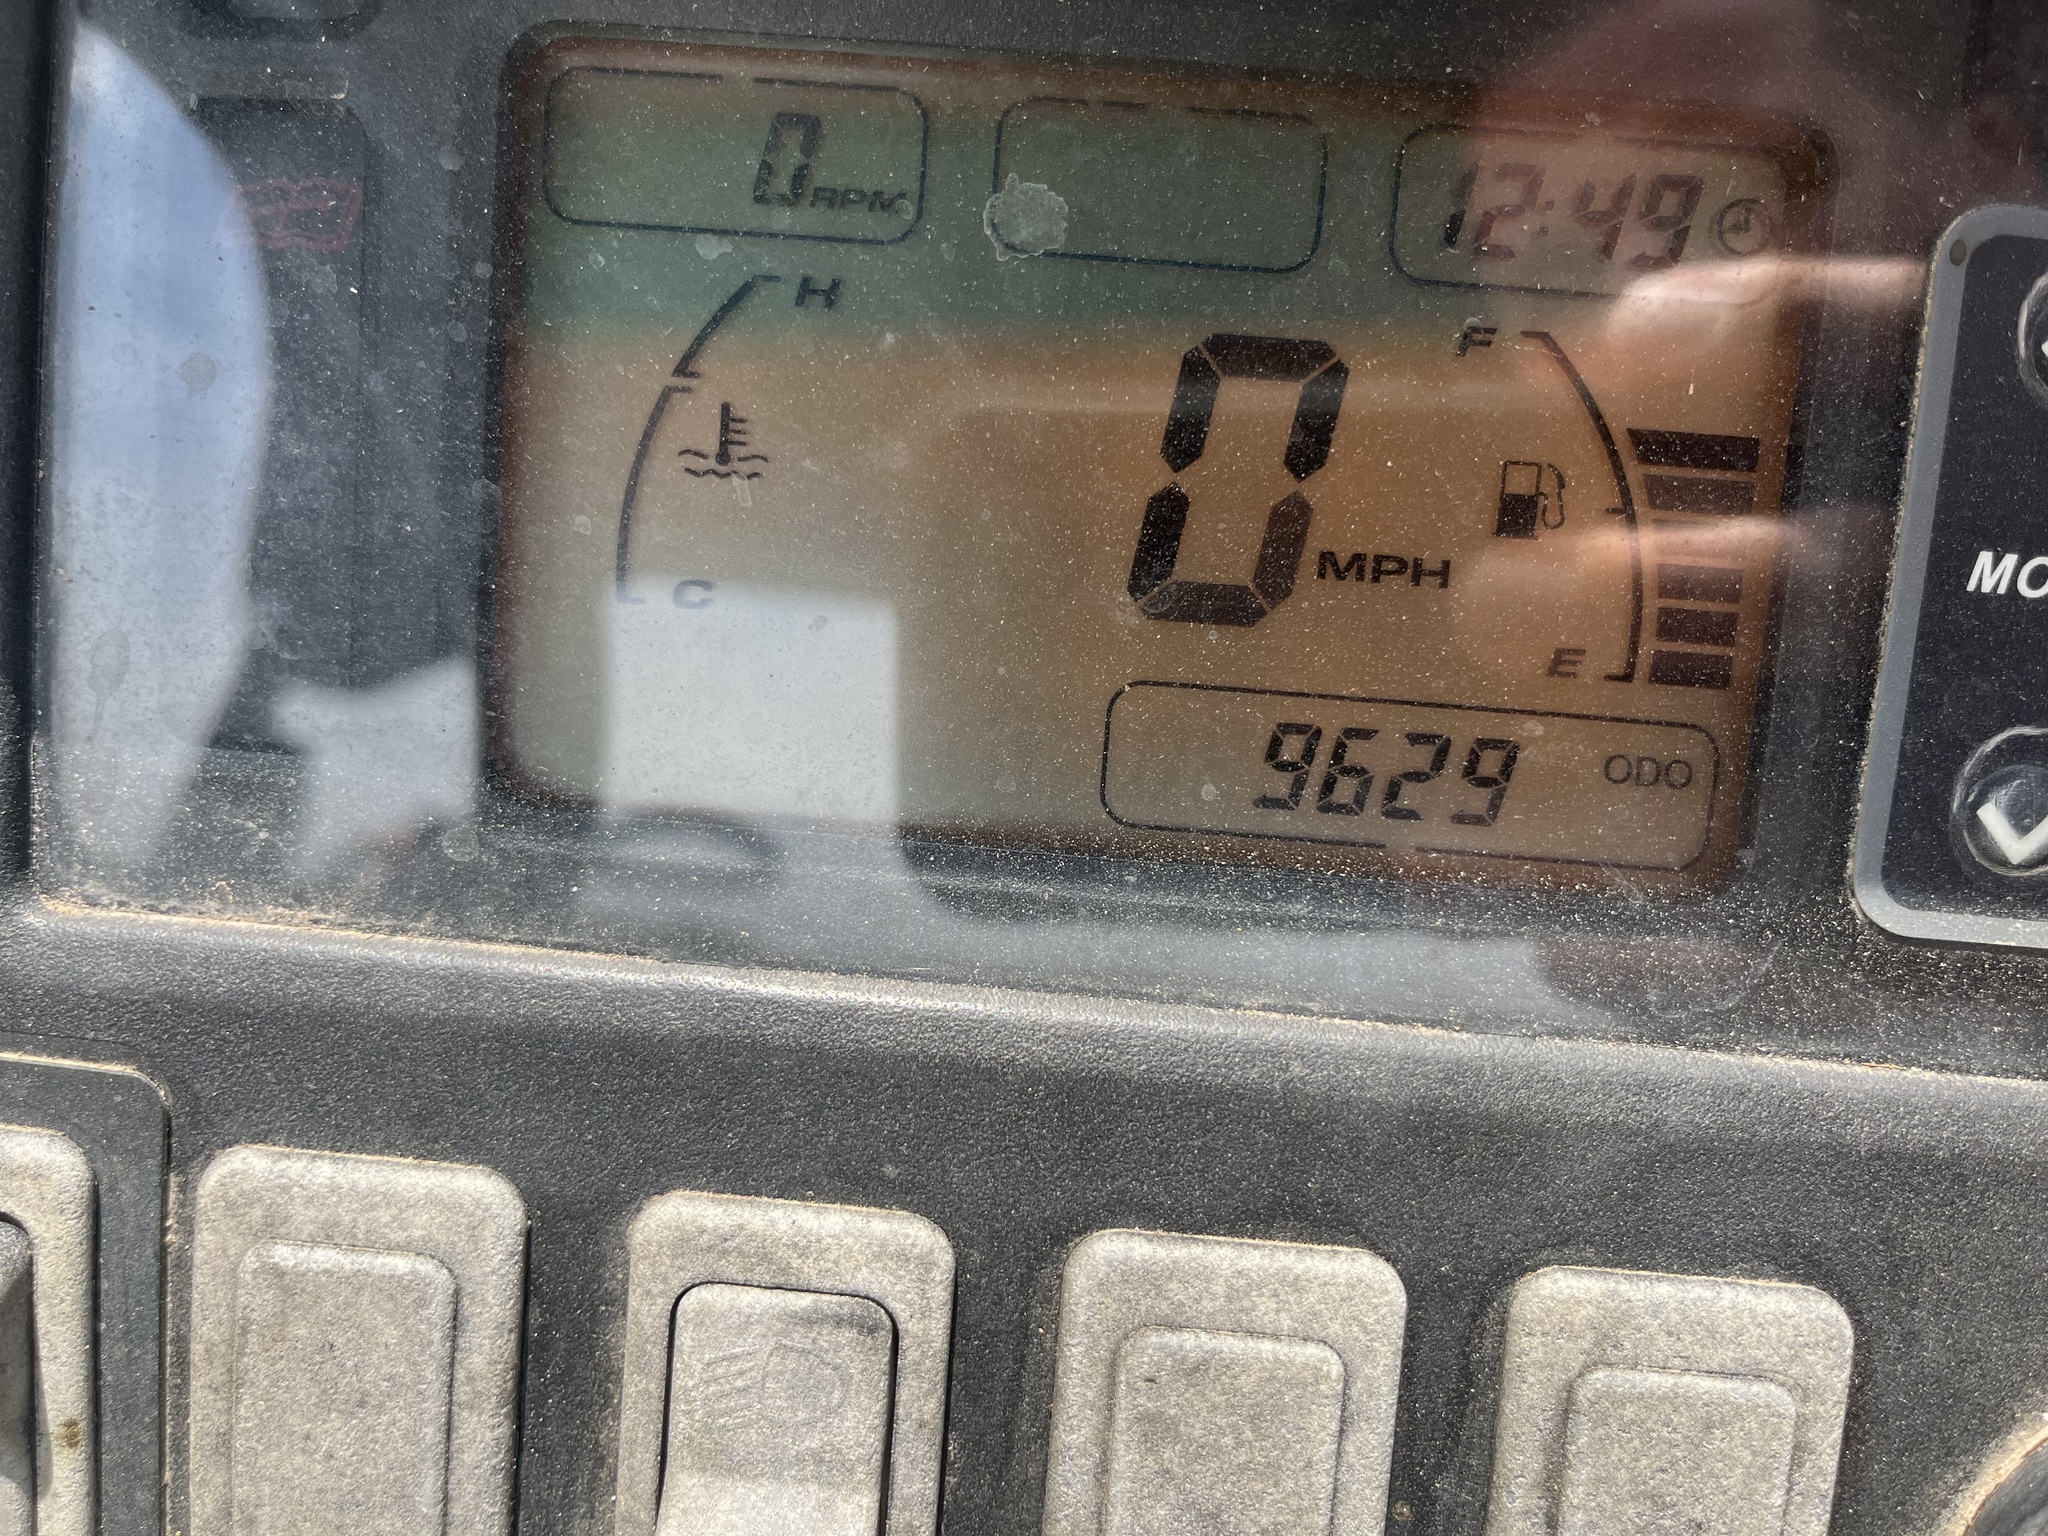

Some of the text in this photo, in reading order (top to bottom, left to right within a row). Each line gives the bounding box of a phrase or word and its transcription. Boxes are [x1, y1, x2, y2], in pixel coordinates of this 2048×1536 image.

[752, 112, 908, 214] 0 RPM
[1442, 161, 1704, 269] 12:49
[794, 276, 842, 309] H
[1456, 325, 1498, 357] F
[1127, 332, 1452, 628] 0 MPH
[671, 579, 716, 611] C
[1545, 647, 1587, 679] E
[1252, 721, 1693, 827] 9629 ODO
